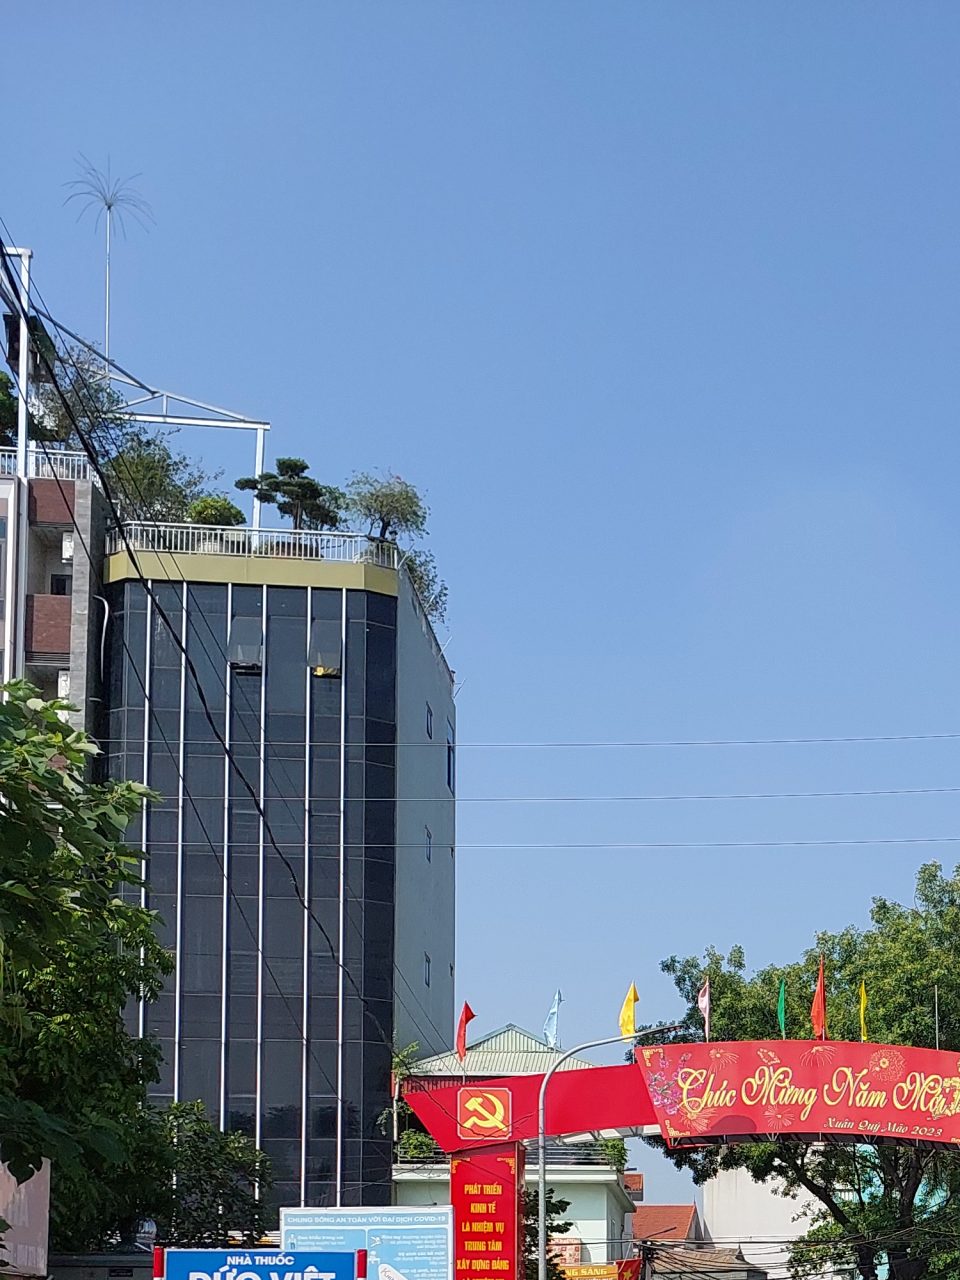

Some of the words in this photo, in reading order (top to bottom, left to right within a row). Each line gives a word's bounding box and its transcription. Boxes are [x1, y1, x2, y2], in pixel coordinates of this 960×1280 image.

[678, 1068, 736, 1112] Chúc
[741, 1066, 818, 1121] Mừng
[823, 1066, 888, 1108] Năm
[824, 1117, 854, 1129] Xuân
[858, 1119, 881, 1132] Quý
[881, 1122, 908, 1134] Mão
[911, 1125, 942, 1137] 2023
[464, 1183, 482, 1194] PHÁT
[483, 1182, 502, 1194] TRIỂN
[470, 1203, 487, 1214] KINH
[488, 1201, 496, 1214] TẾ
[462, 1222, 470, 1232] LÀ
[472, 1221, 494, 1234] NHIỆM
[495, 1222, 504, 1234] VỤ
[464, 1241, 486, 1252] TRUNG
[488, 1240, 502, 1252] TÂM
[227, 1254, 252, 1266] NHÀ
[254, 1252, 294, 1266] THUỐC
[456, 1258, 470, 1270] XÂY
[472, 1260, 490, 1272] DỰNG
[492, 1257, 510, 1270] ĐẢNG
